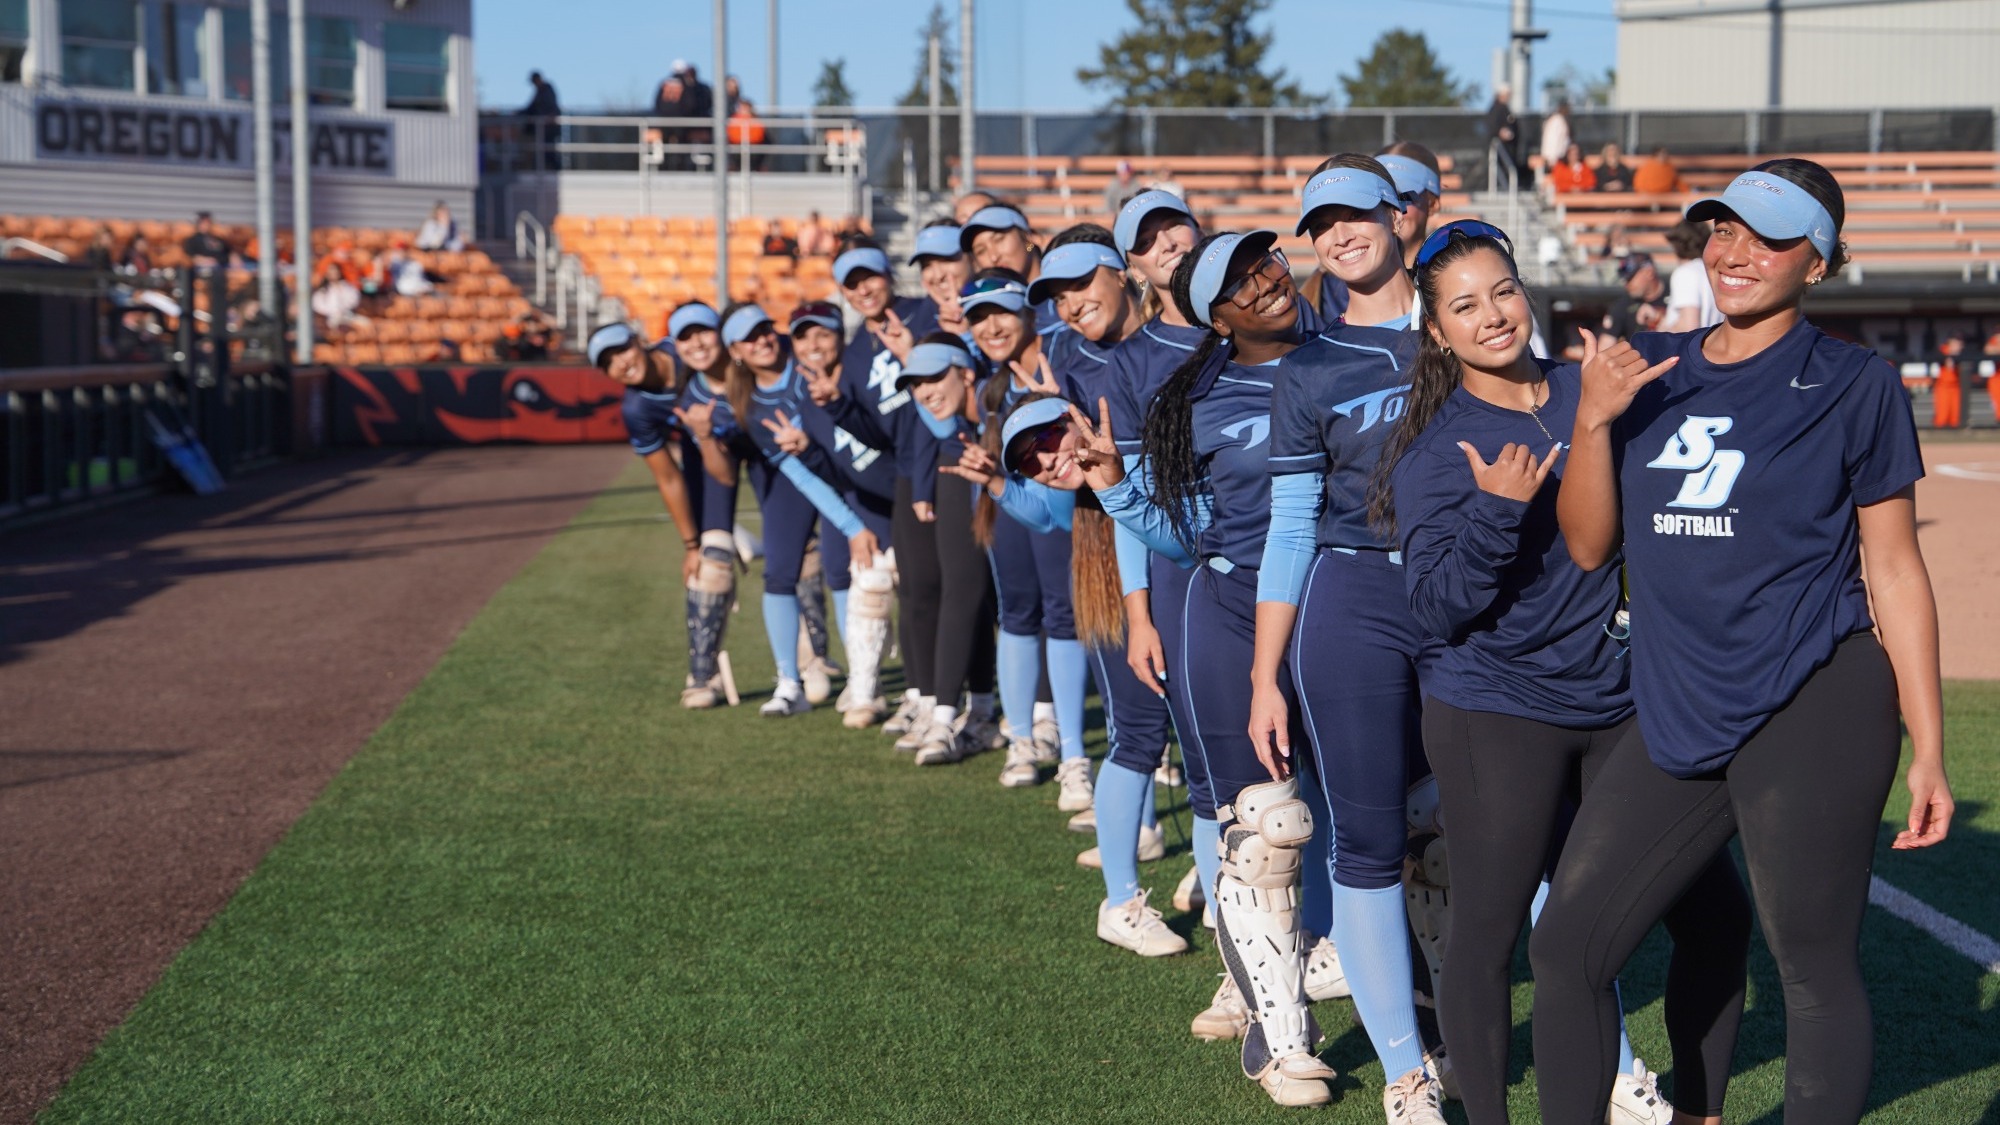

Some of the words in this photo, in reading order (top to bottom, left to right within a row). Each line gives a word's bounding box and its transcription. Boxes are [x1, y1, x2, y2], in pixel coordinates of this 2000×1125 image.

[40, 105, 240, 162] OREGON
[1646, 415, 1745, 509] SD
[1653, 513, 1734, 537] SOFTBALL
